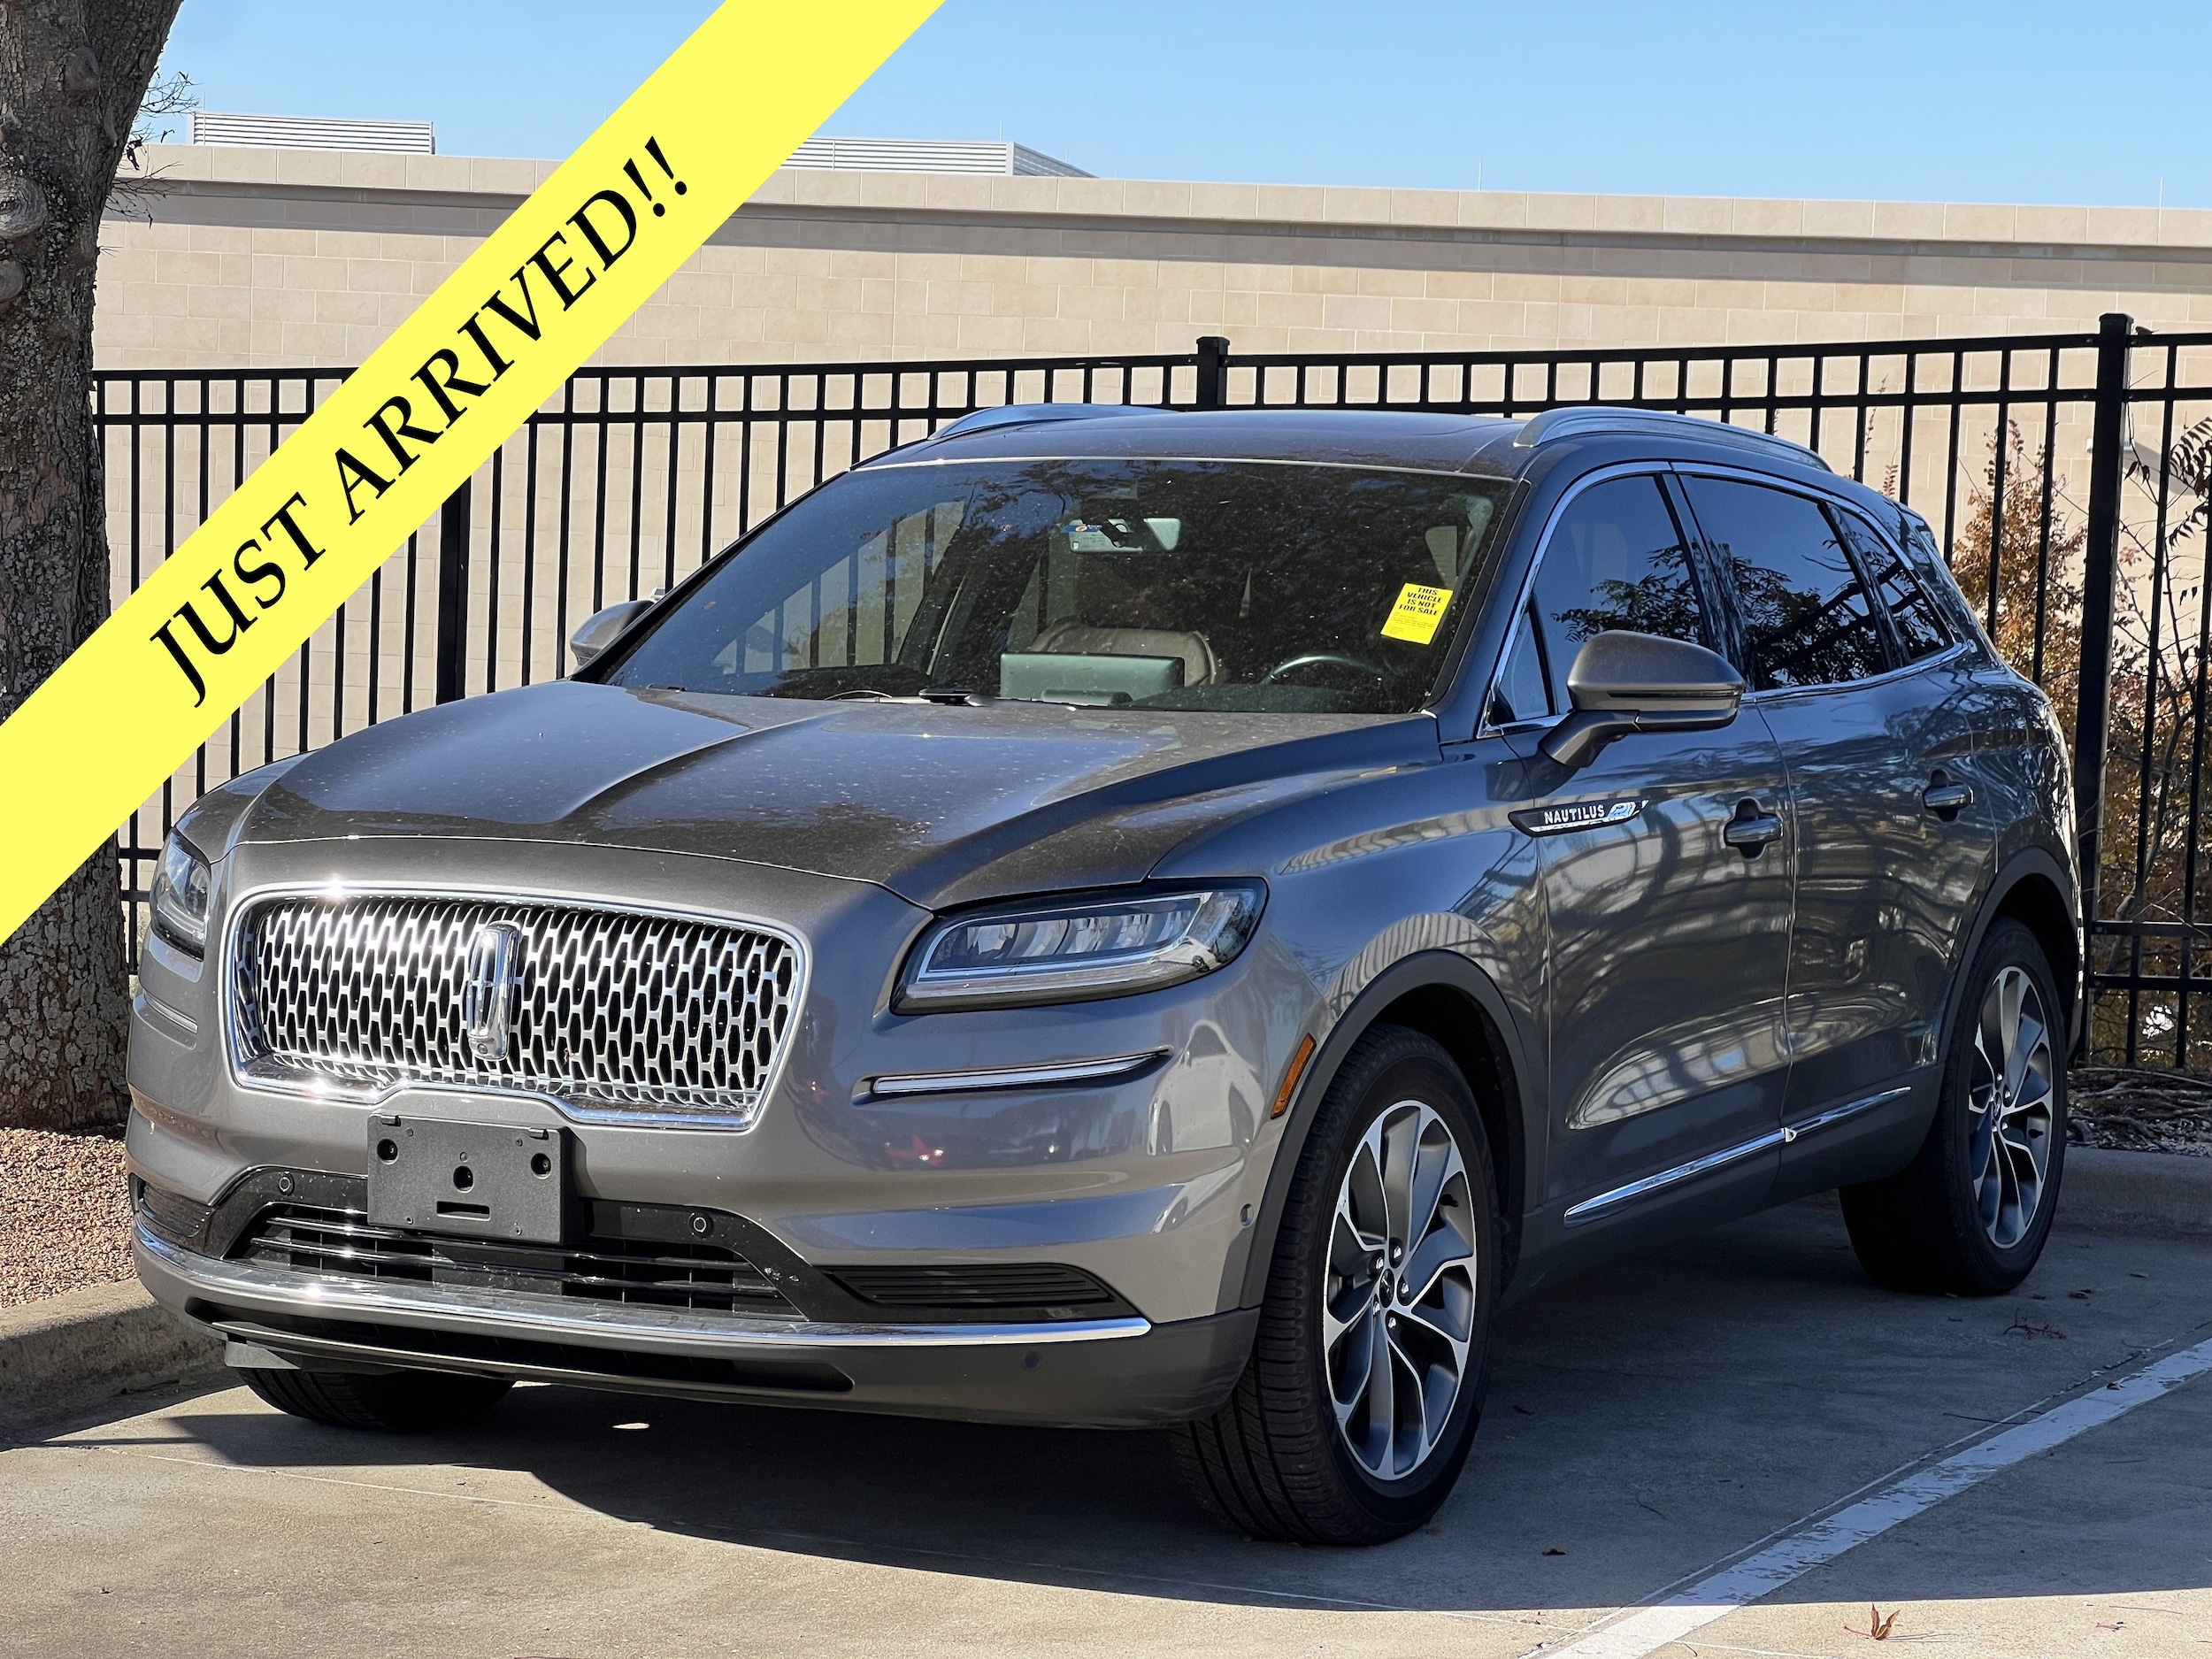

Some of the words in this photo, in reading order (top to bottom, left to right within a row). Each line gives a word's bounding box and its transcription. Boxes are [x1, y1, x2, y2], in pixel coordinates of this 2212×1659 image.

[1407, 592, 1443, 603] VEHICLE
[1399, 603, 1416, 612] FOR
[1417, 607, 1440, 616] SALE
[1544, 803, 1605, 825] NAUTILUS
